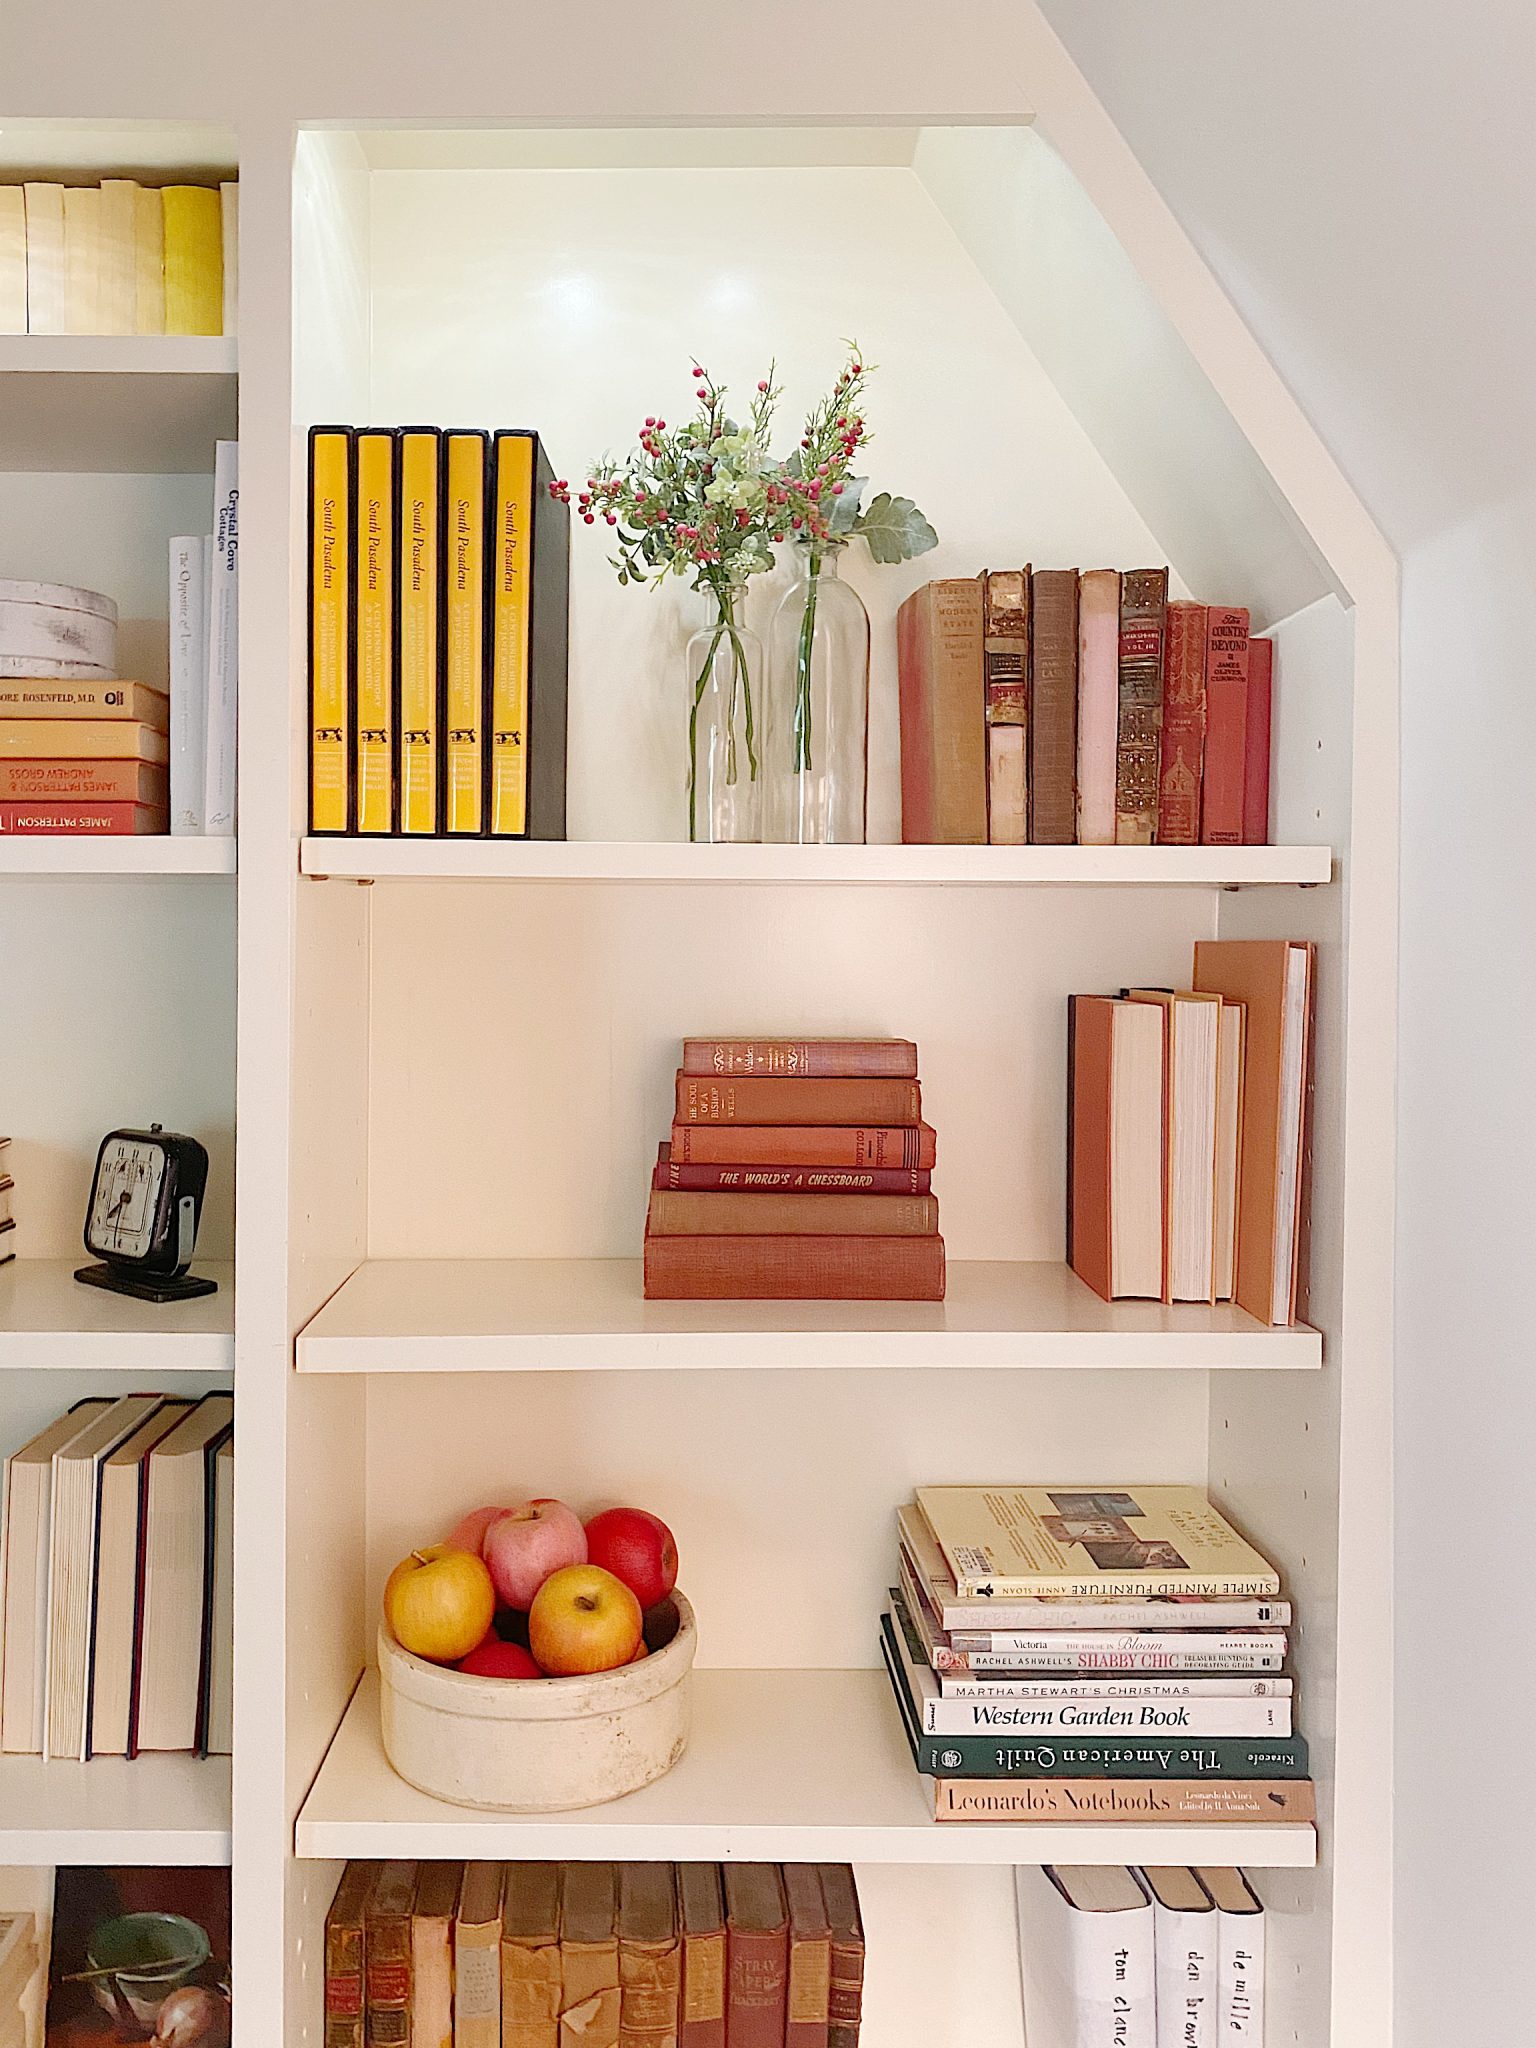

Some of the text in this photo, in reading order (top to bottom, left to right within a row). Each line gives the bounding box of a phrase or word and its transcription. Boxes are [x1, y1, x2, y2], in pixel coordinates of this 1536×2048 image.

[217, 507, 228, 552] Cottages
[226, 489, 239, 571] Crystal Cove
[323, 498, 336, 589] South Pasadena
[368, 499, 381, 590] South Pasadena
[412, 499, 426, 591] South Pasadena
[457, 499, 471, 590] South Pasadena
[504, 501, 518, 592] South Pasadena
[178, 570, 190, 617] Opposite
[943, 620, 974, 628] STATE
[1222, 615, 1241, 625] The
[1212, 626, 1248, 638] COUNTRY
[1211, 640, 1248, 652] BEYOND
[9, 768, 94, 778] ANDREW GROSS
[20, 782, 81, 791] PATTERSON
[83, 782, 117, 791] JAMES
[17, 817, 77, 827] PATTERSON
[79, 817, 111, 827] JAMES
[744, 1045, 753, 1074] Walden
[690, 1083, 698, 1105] SOUL
[710, 1087, 720, 1119] BISHOP
[728, 1088, 736, 1118] WELLS
[719, 1172, 874, 1187] THE WORLD'S A CHESSBOARD
[1071, 1584, 1152, 1595] FURNITURE
[1157, 1584, 1217, 1594] PAINTED
[1223, 1583, 1272, 1593] SIMPLE
[1103, 1612, 1147, 1620] RACHEL
[1154, 1612, 1207, 1620] ASHWELL
[1013, 1639, 1048, 1649] Victoria
[1118, 1636, 1163, 1650] Bloom
[976, 1653, 1179, 1668] RACHEL ASHWELL'S SHABBY CHIC
[956, 1686, 1191, 1696] MARTHA STEWART'S CHRISTMAS
[928, 1702, 936, 1732] Sunset
[972, 1706, 1191, 1726] Western Garden Book
[996, 1746, 1295, 1771] Kiracofe The American Quilt
[949, 1788, 1171, 1810] Leonardo's Notebooks
[1185, 1790, 1252, 1799] Leonardo da Vinci
[1179, 1801, 1205, 1811] Edited
[1205, 1801, 1213, 1812] by
[1225, 1801, 1245, 1811] Anna
[1114, 1948, 1129, 1981] tom
[1187, 1951, 1204, 1981] dan
[1230, 1950, 1252, 2031] de mille
